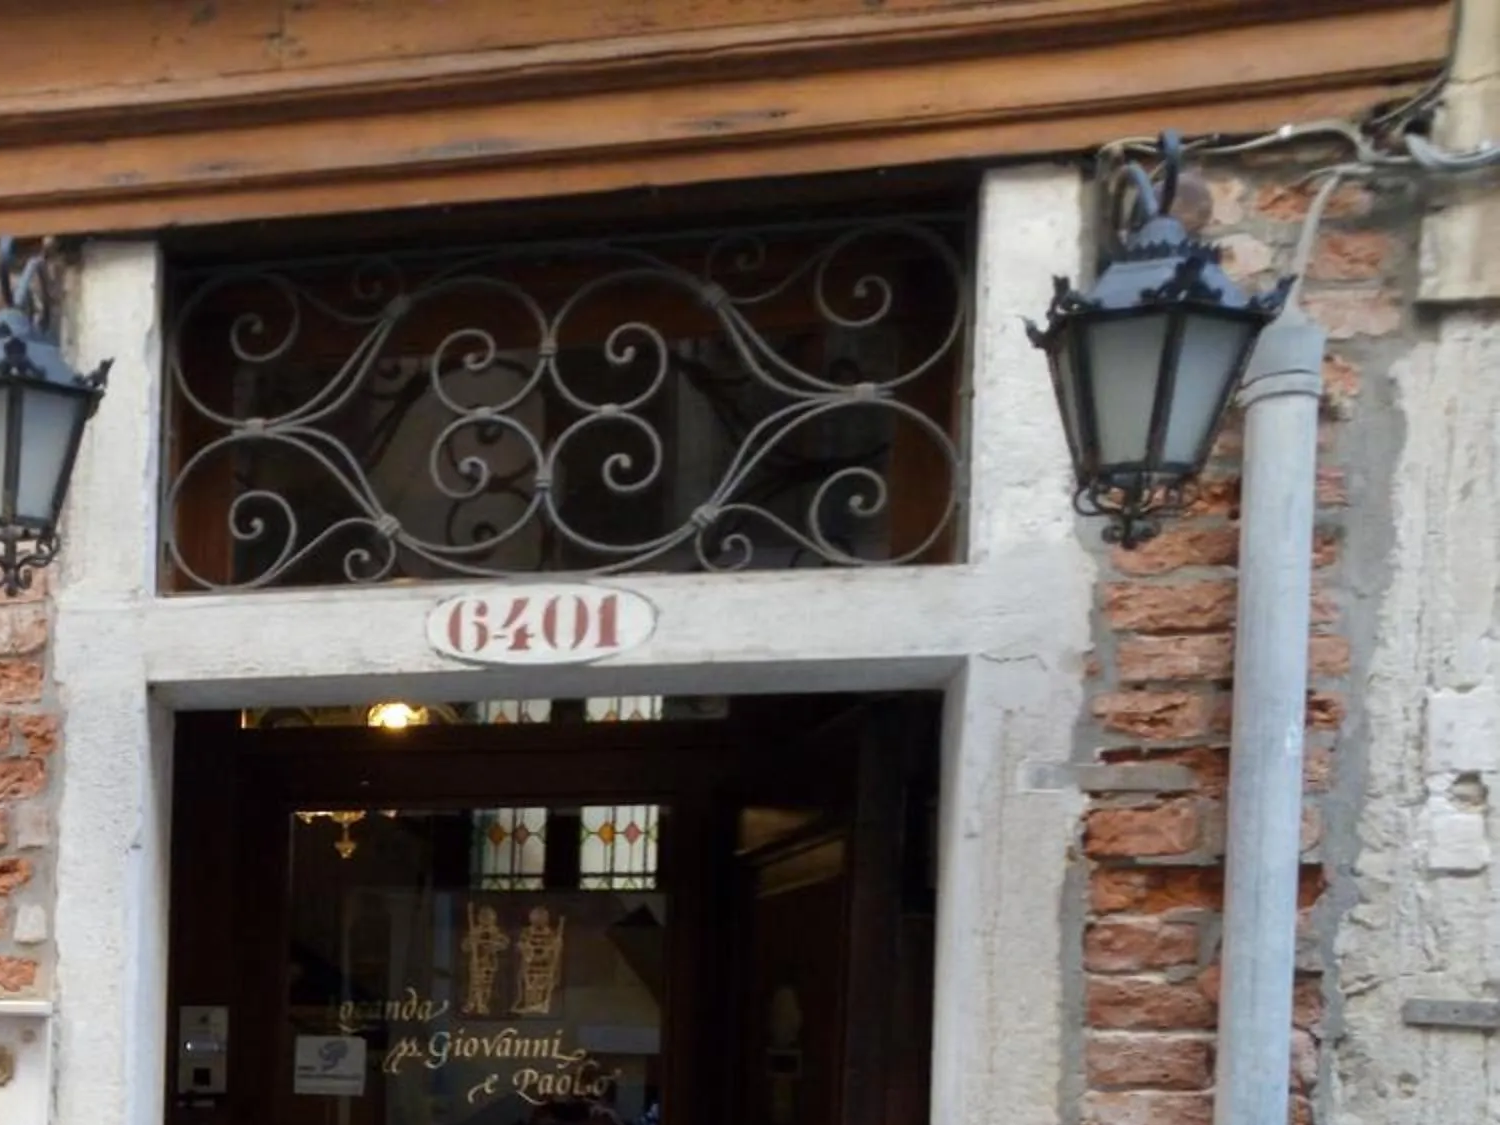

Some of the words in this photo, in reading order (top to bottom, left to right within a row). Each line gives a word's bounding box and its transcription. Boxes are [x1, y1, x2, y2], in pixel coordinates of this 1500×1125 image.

[447, 594, 620, 653] 6401
[424, 1027, 587, 1069] Giovanni
[467, 1073, 499, 1103] e
